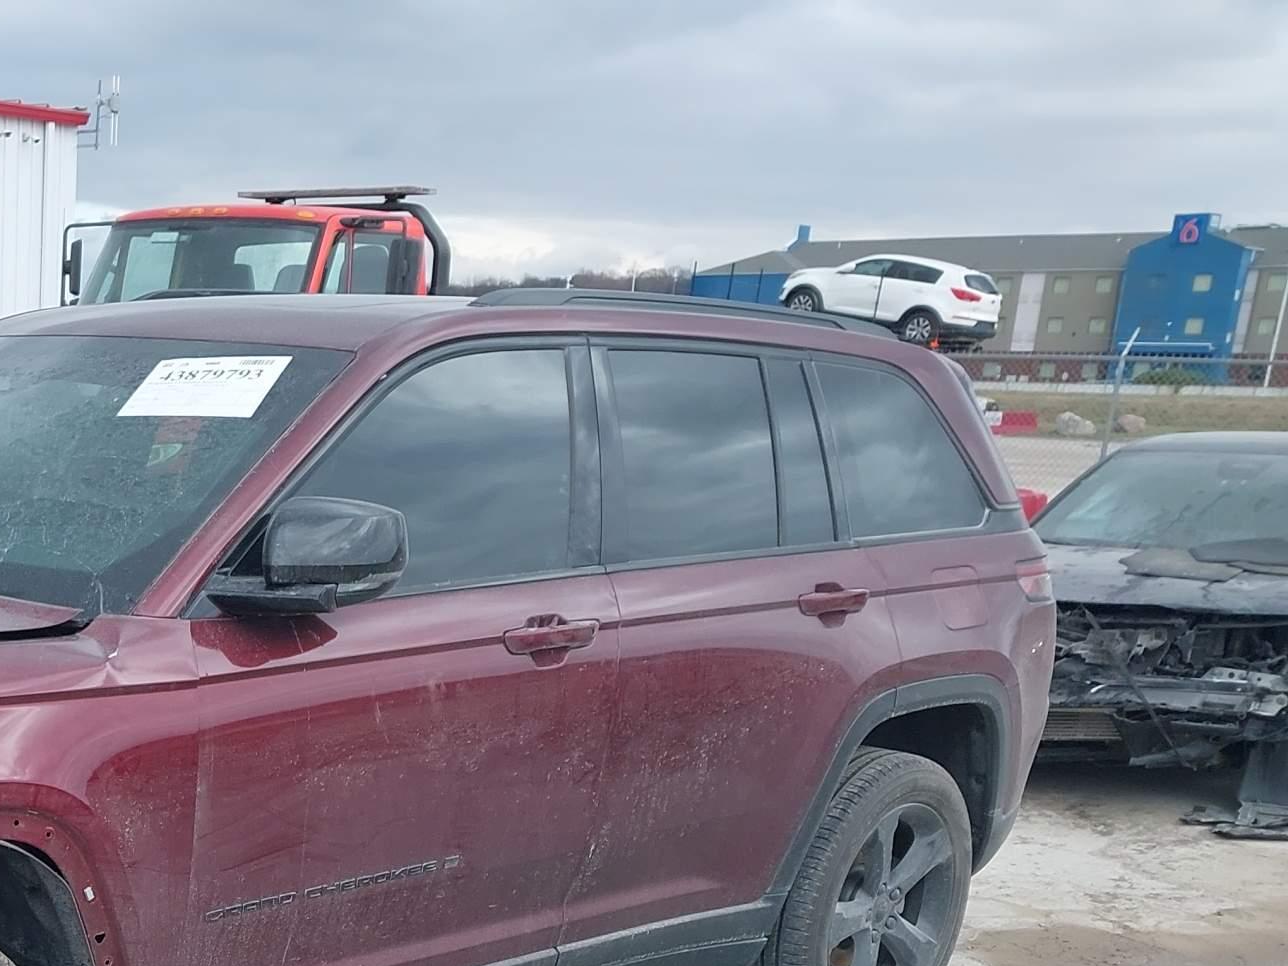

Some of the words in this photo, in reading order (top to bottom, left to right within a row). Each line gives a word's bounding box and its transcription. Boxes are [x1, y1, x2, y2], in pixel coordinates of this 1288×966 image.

[1179, 217, 1199, 244] 6
[159, 368, 265, 381] 43879793
[304, 859, 438, 899] CHEROKEE
